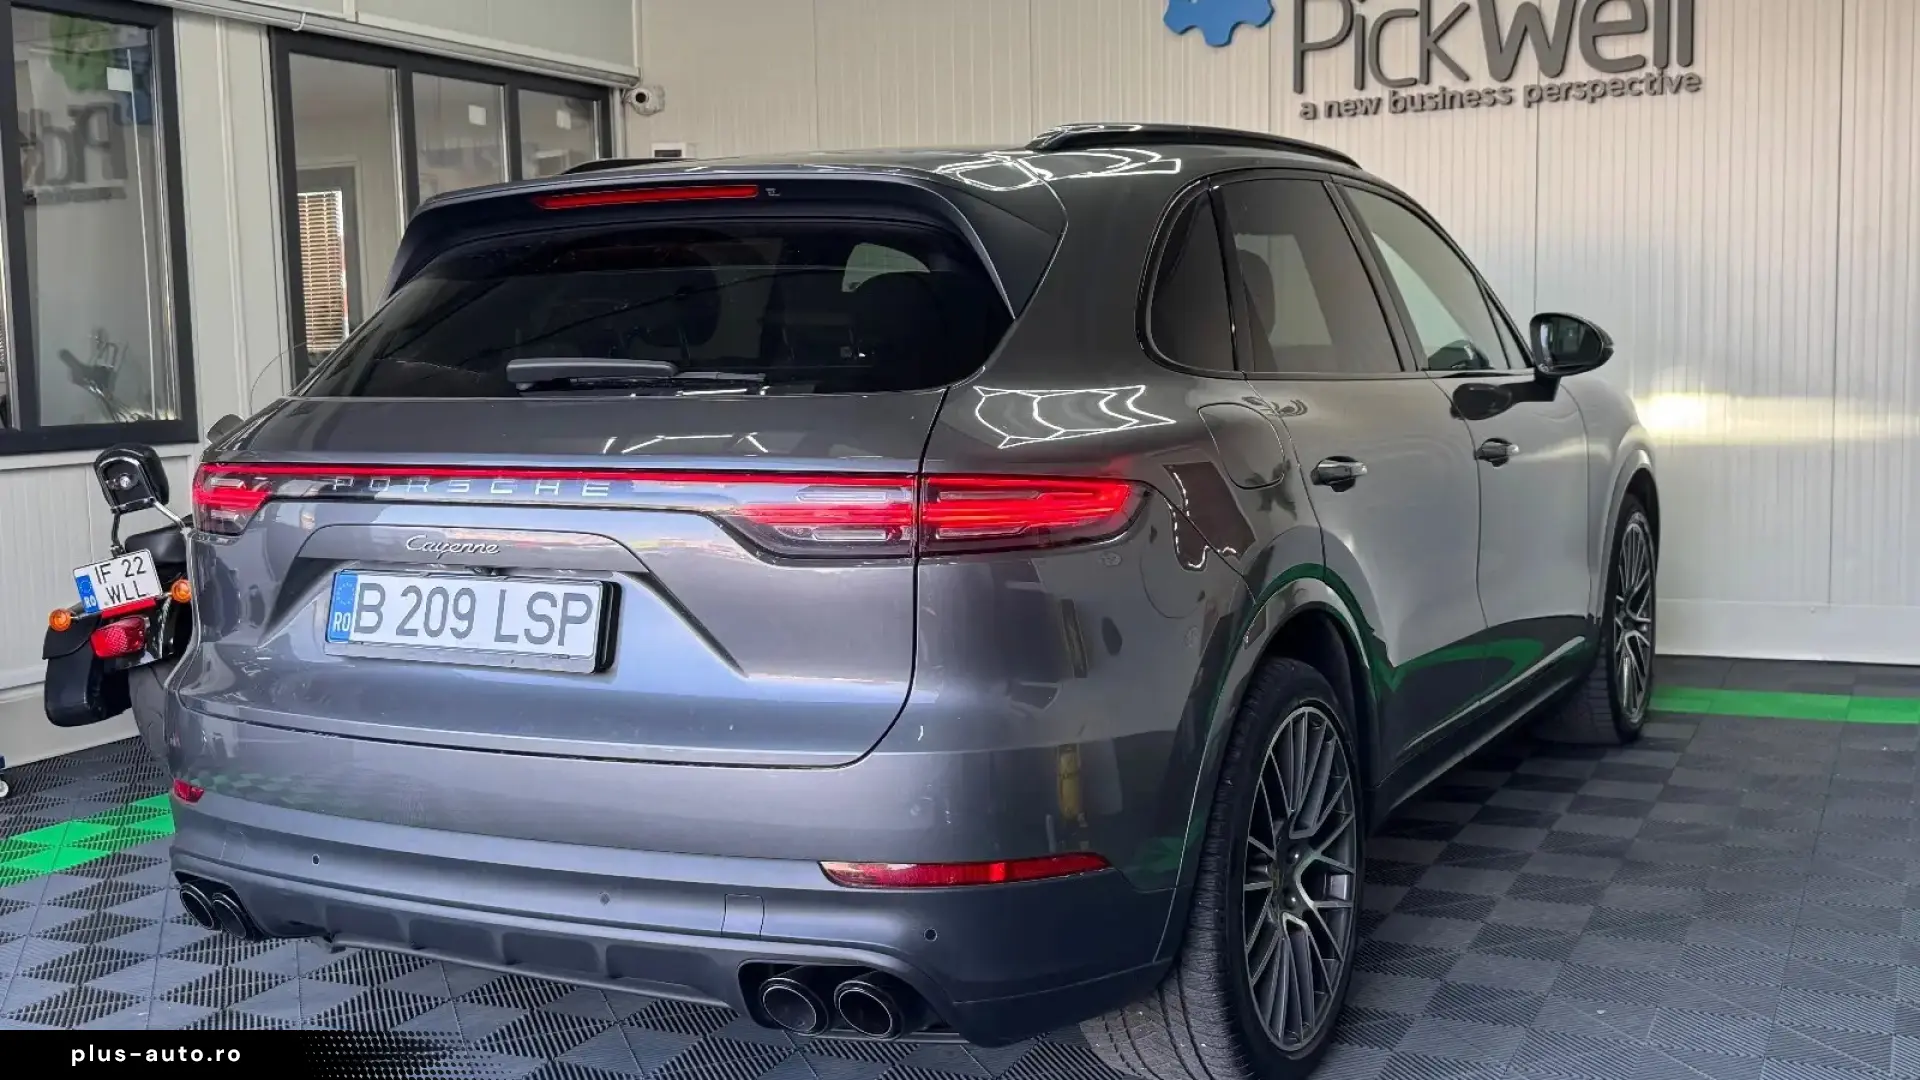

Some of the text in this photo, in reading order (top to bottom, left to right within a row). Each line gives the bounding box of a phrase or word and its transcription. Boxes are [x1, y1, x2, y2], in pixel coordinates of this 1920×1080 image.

[1300, 68, 1702, 120] a new business perspective
[333, 475, 610, 497] PORSCHE
[406, 534, 501, 560] Cayenne
[94, 556, 146, 585] IF 22
[84, 595, 97, 608] RO
[105, 580, 146, 604] WLL
[333, 611, 352, 632] RO
[354, 583, 594, 647] B 209 LSP
